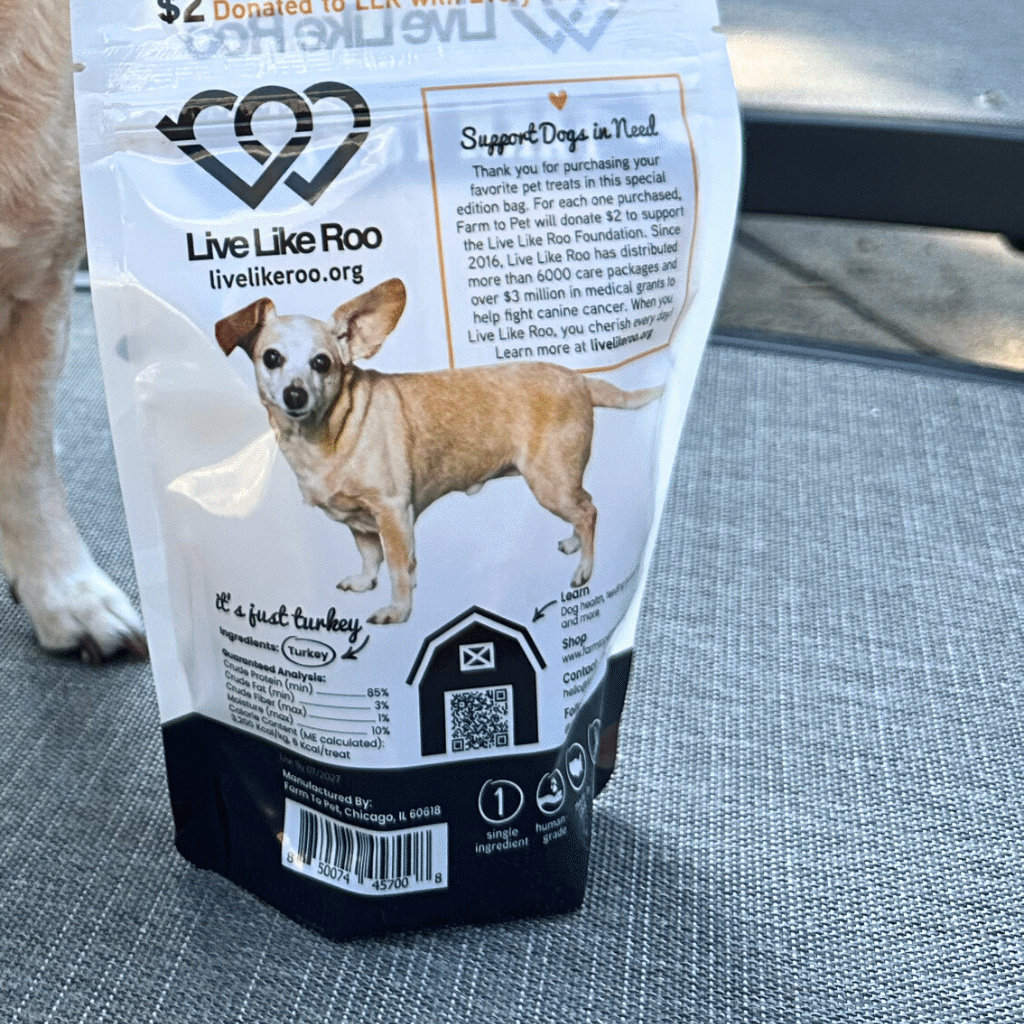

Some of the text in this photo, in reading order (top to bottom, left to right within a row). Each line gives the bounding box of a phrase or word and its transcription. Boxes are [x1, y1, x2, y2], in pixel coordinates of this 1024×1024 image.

[460, 113, 659, 156] Support Dogs in Need
[471, 156, 660, 179] Thank you for purchasing your
[470, 170, 667, 196] favorite pet treats in this special
[456, 201, 500, 216] edition
[503, 199, 530, 215] bag.
[533, 196, 555, 210] For
[558, 194, 588, 208] each
[591, 194, 614, 206] one
[456, 205, 685, 234] Farm to Pet will donate $2 to support
[186, 222, 383, 261] Live Like Roo
[463, 222, 682, 252] the Live Like Roo Foundation. Since
[468, 239, 679, 270] 2016, Live Like Roo has distributed
[209, 263, 365, 290] livelikeroo.org
[467, 257, 678, 288] more than 6000 care packages and
[470, 275, 677, 306] over $3 million in medical grants to
[472, 294, 674, 326] help fight canine cancer. When you
[467, 328, 495, 344] Live
[497, 326, 526, 342] Like
[528, 324, 558, 339] Roo,
[560, 323, 585, 339] you
[587, 317, 632, 335] cherish
[632, 314, 656, 328] every
[494, 345, 534, 360] Learn
[536, 343, 571, 357] more
[574, 341, 588, 354] at
[560, 585, 590, 603] Learn
[248, 603, 290, 628] just
[291, 606, 363, 644] turkey
[560, 604, 579, 618] Dog
[560, 616, 579, 629] and
[219, 626, 329, 663] Ingredients: Turkey
[562, 632, 588, 650] Shop
[221, 647, 327, 684] Guaranteed Analysis:
[223, 658, 314, 695] Crude Protein (min)
[224, 670, 296, 704] Crude Fat (min)
[226, 681, 308, 718] Crude Fiber (max)
[366, 687, 390, 699] 85%
[227, 693, 295, 725] Moisture (max)
[374, 700, 390, 711] 3%
[377, 713, 391, 724] 1%
[228, 703, 386, 750] Calorie Content (ME calculated):
[371, 725, 391, 736] 10%
[299, 739, 351, 760] Kcal/treat
[282, 768, 373, 810] Manufactured By:
[284, 781, 442, 825] Farm To Pet, Chicago, IL 60618
[486, 826, 520, 840] single
[535, 815, 567, 833] human
[542, 826, 568, 845] grade
[475, 836, 529, 855] ingredient
[286, 851, 443, 890] 8 50074 45700 8
